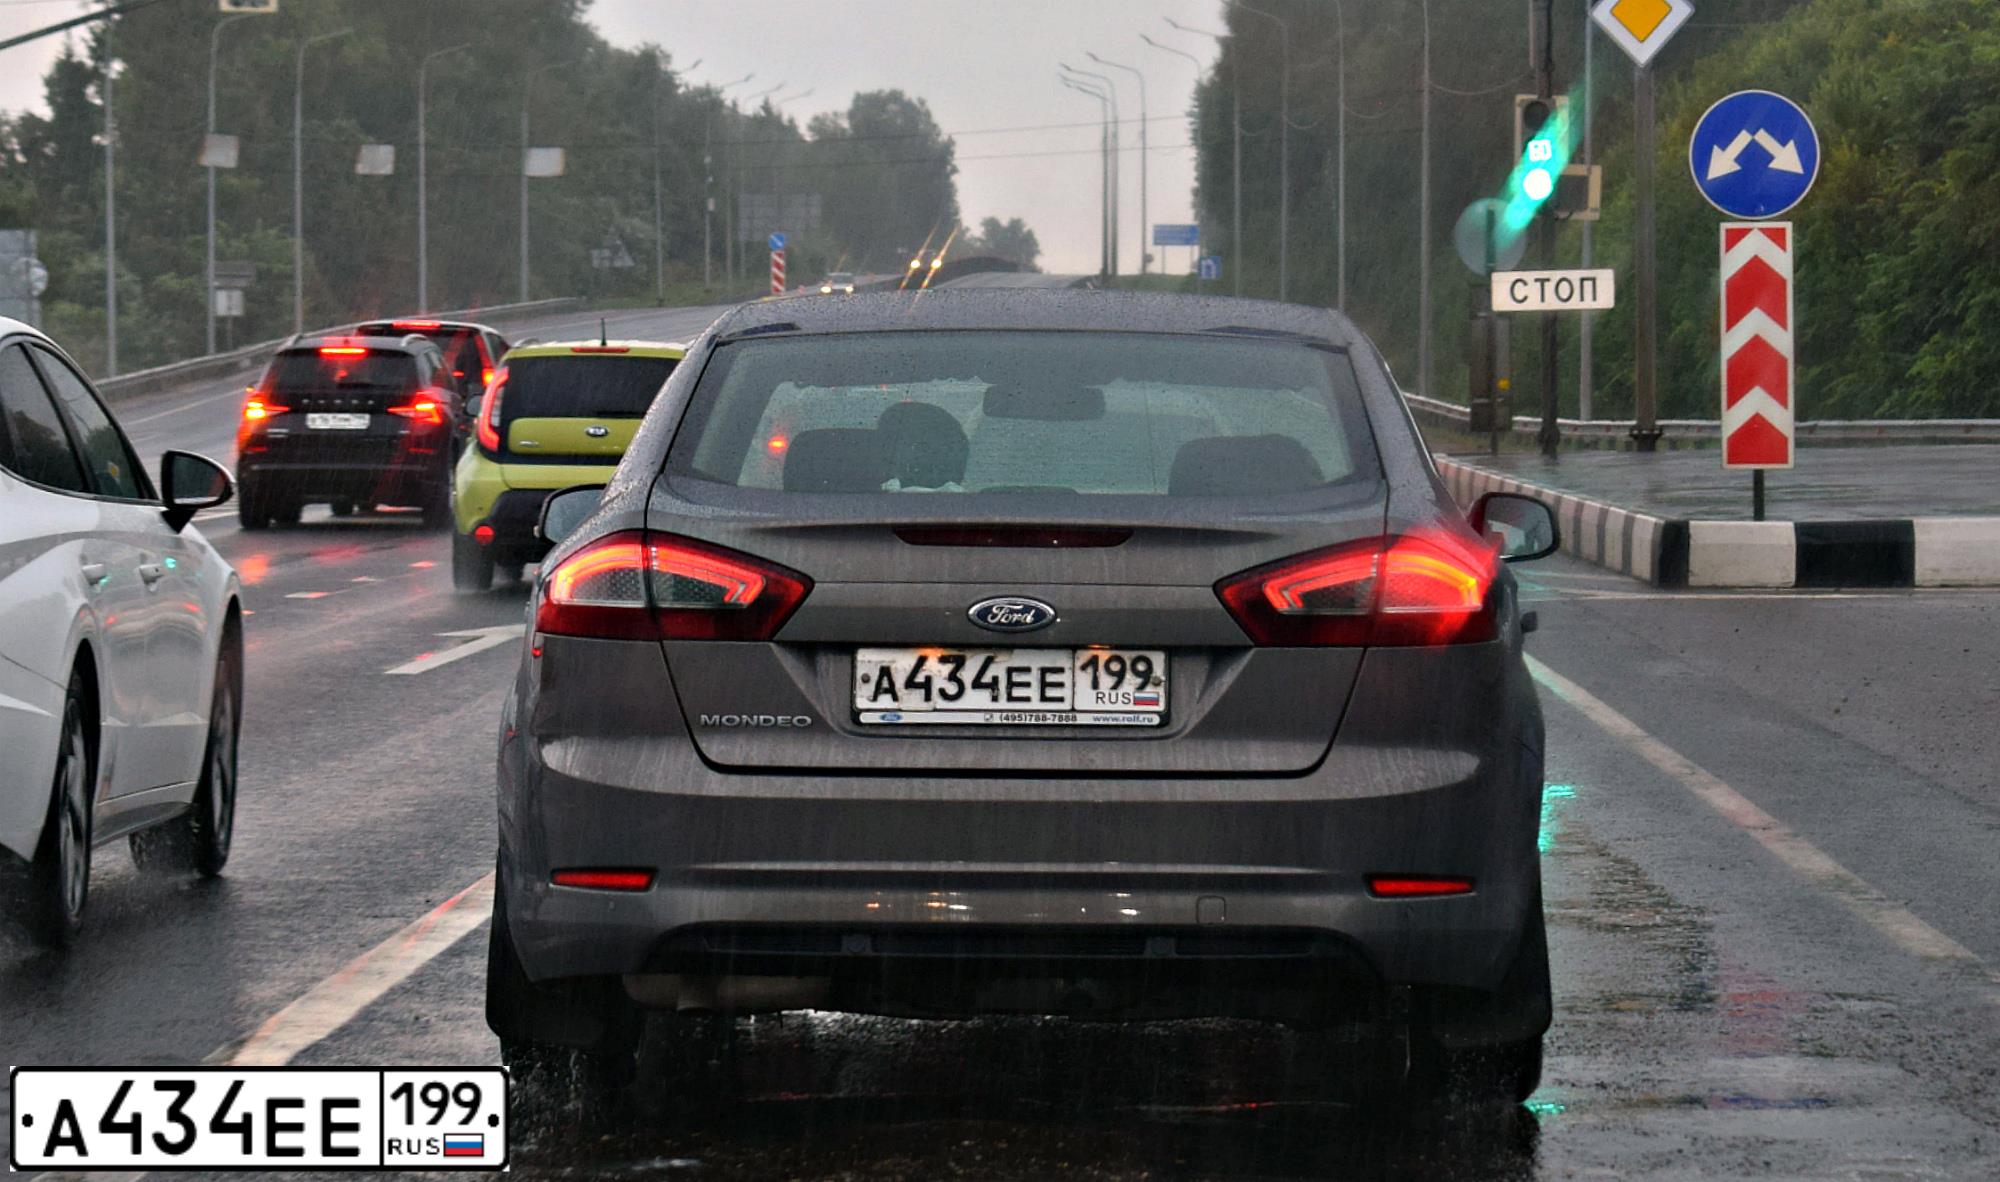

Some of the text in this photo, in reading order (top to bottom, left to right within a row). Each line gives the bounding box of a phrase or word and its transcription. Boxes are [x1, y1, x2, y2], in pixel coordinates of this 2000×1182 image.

[1510, 276, 1597, 304] СТОП
[987, 604, 1035, 624] Ford
[1080, 654, 1154, 690] 199
[1095, 691, 1132, 705] RUS
[700, 714, 812, 727] MONDEO
